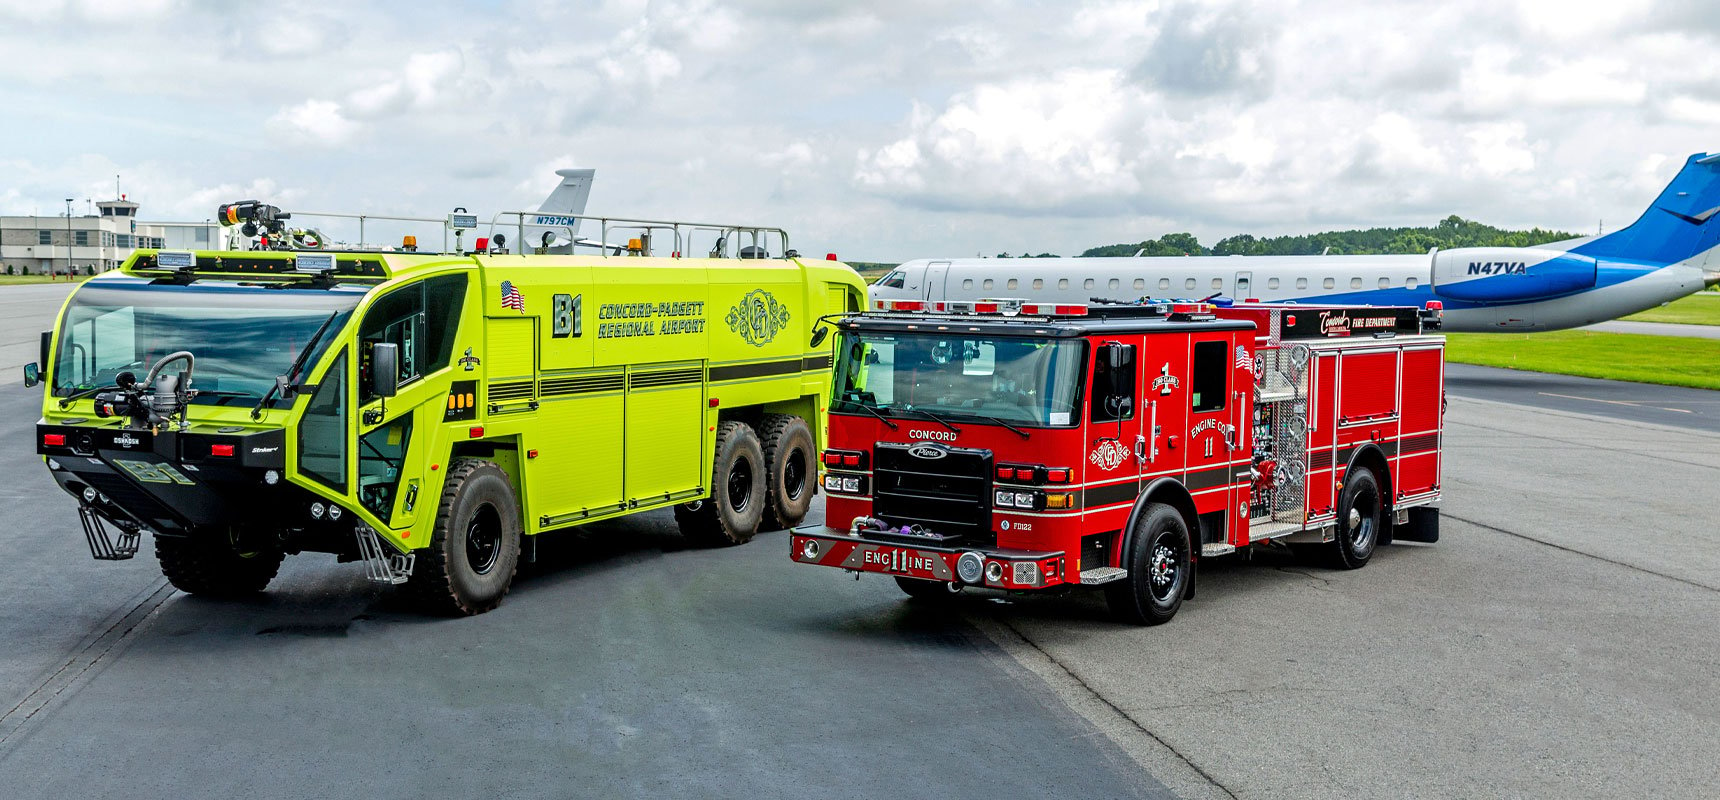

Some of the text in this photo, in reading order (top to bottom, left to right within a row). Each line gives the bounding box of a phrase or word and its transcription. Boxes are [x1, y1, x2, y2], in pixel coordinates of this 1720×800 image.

[537, 216, 575, 226] N797CM
[1467, 262, 1526, 275] N47VA
[552, 294, 582, 338] B1
[599, 301, 705, 319] CONCORD-PADGETT
[598, 319, 706, 338] REGIONAL AIRPORT
[1352, 317, 1365, 328] FIRE
[1365, 317, 1397, 328] DEPARTMENT
[909, 429, 957, 441] CONCORD
[1191, 418, 1217, 440] ENGINE
[916, 448, 939, 457] Pierce
[1204, 436, 1213, 459] 11
[112, 458, 196, 485] B1
[1013, 522, 1032, 531] FD122
